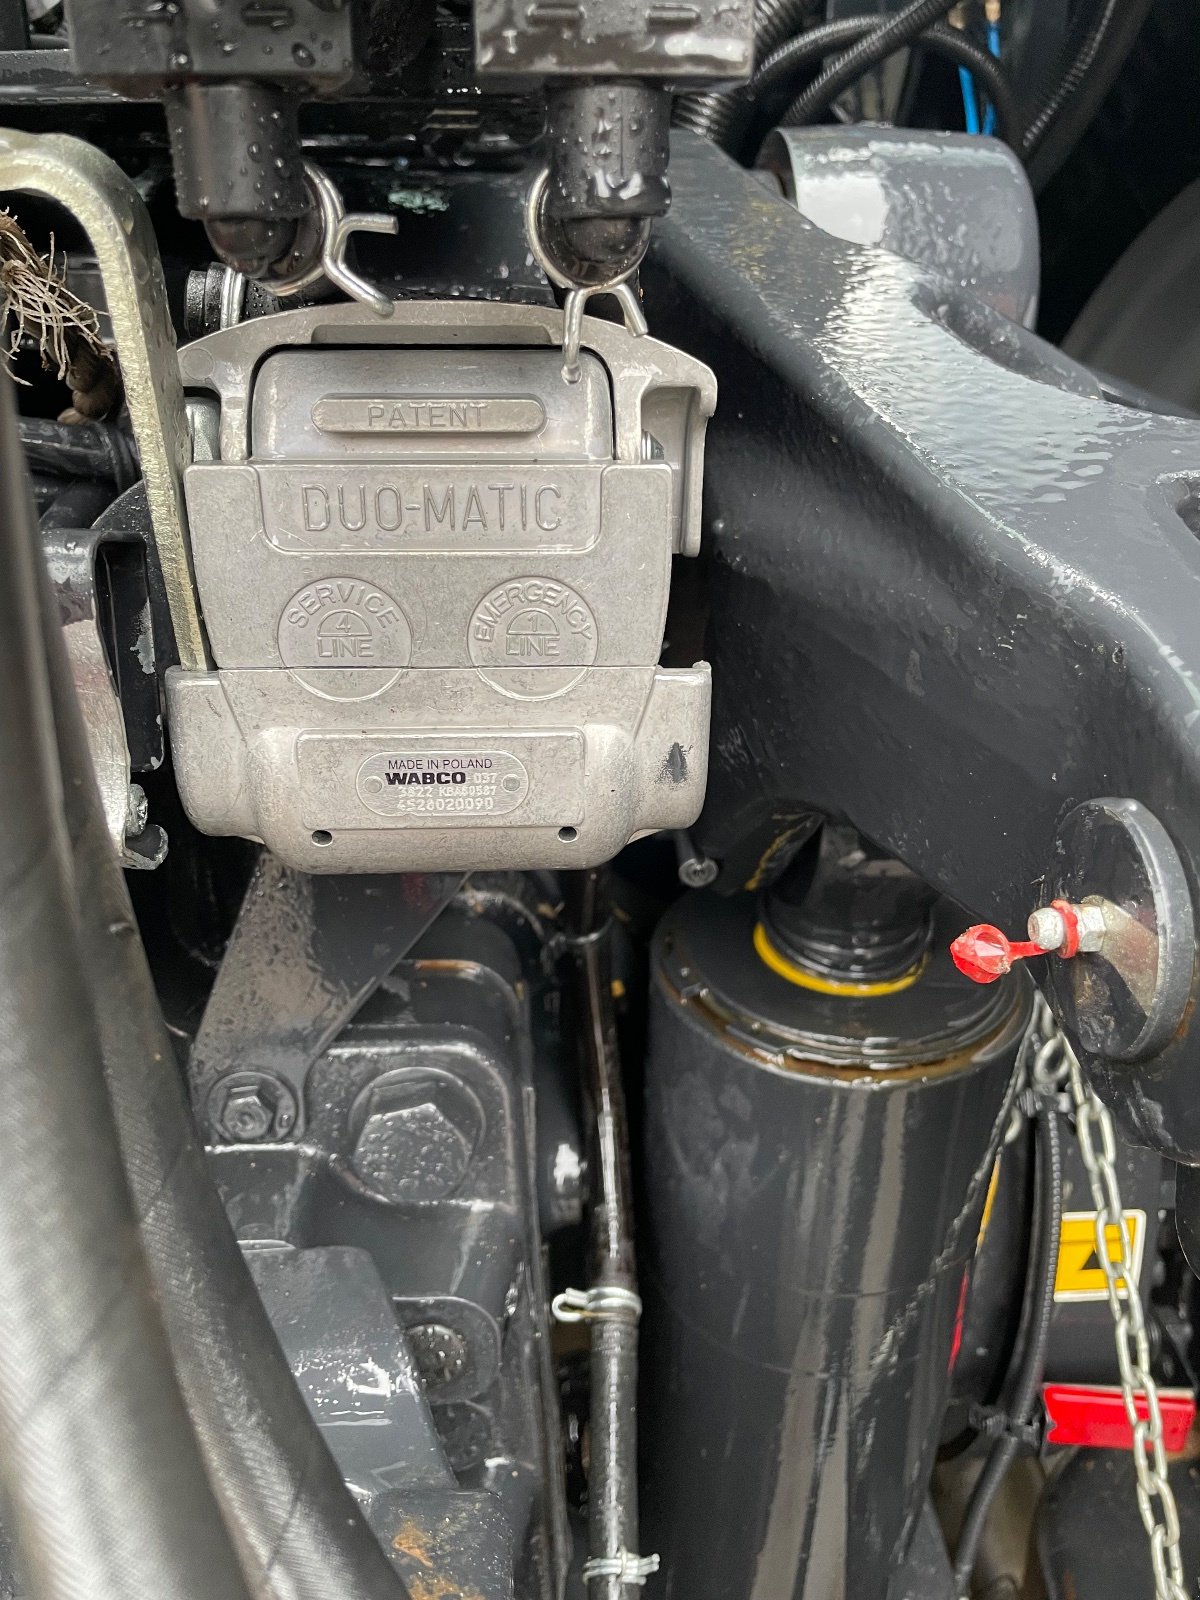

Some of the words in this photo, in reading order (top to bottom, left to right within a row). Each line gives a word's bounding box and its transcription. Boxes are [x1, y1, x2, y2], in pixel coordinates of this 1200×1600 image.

[366, 404, 488, 428] PATENT
[302, 484, 562, 531] DUO-MATIC
[288, 582, 400, 629] SERVICE
[474, 580, 593, 642] EMERGENCY
[336, 613, 351, 633] 4
[527, 612, 539, 632] 1
[317, 637, 374, 658] LINE
[506, 636, 560, 656] LINE
[388, 760, 423, 770] MADE
[427, 760, 439, 769] IN
[443, 759, 493, 769] POLAND
[384, 772, 466, 785] WABCO
